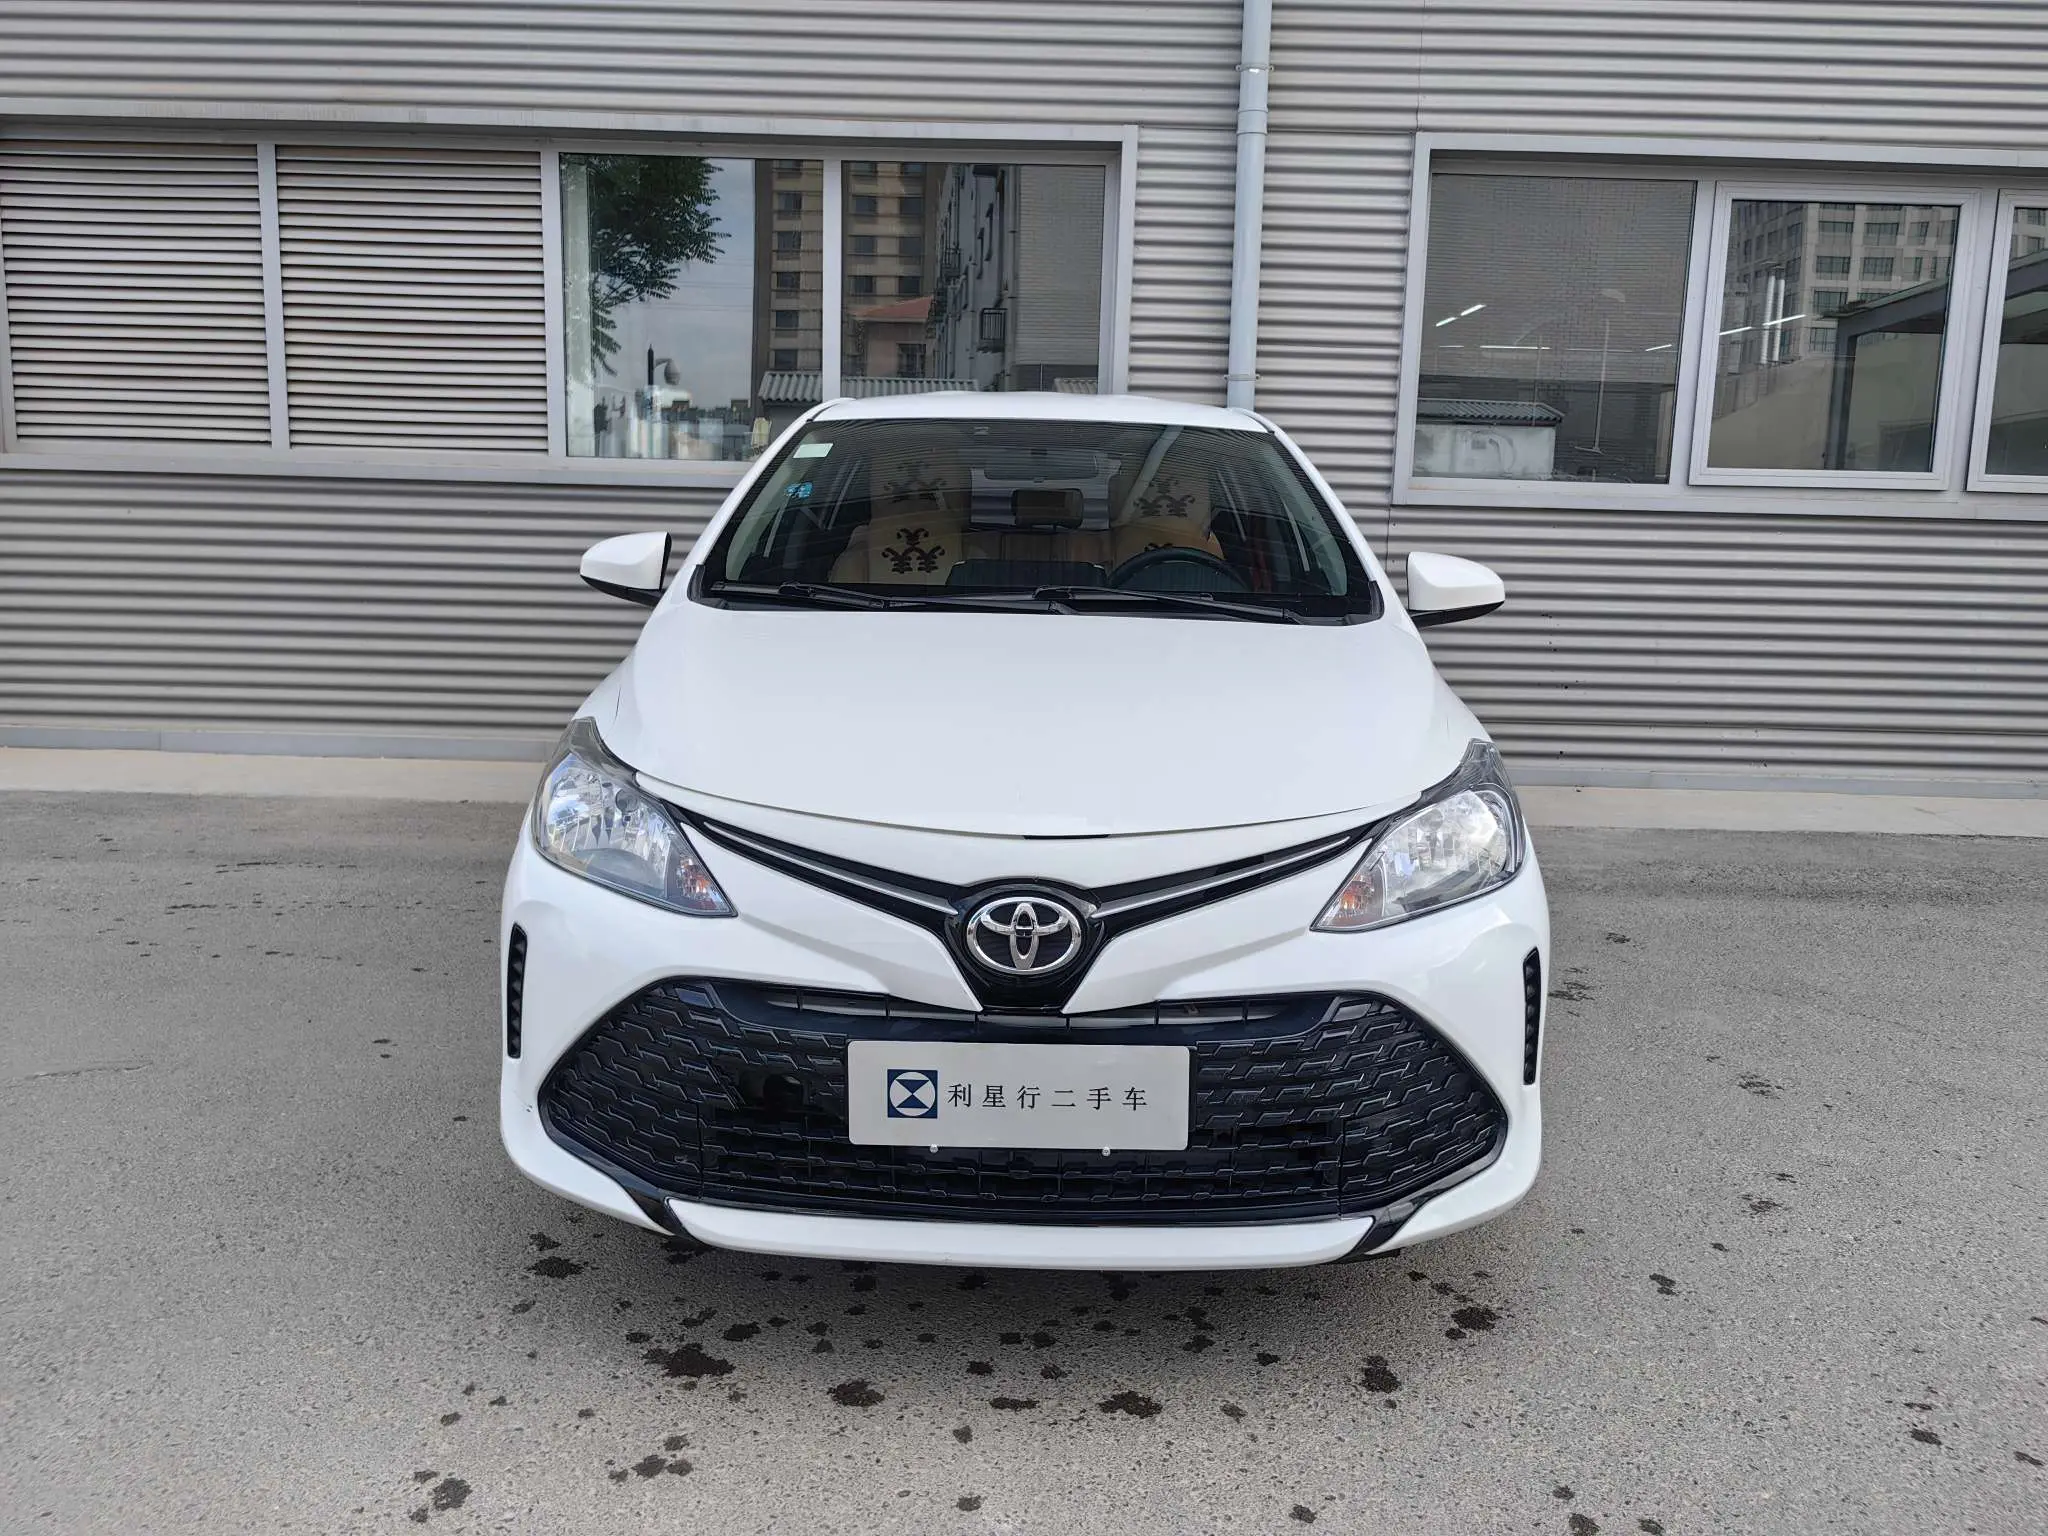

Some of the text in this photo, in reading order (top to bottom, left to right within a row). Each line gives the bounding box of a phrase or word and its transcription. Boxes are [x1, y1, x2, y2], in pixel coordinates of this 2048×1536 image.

[947, 1083, 1147, 1111] 利星行二手车
